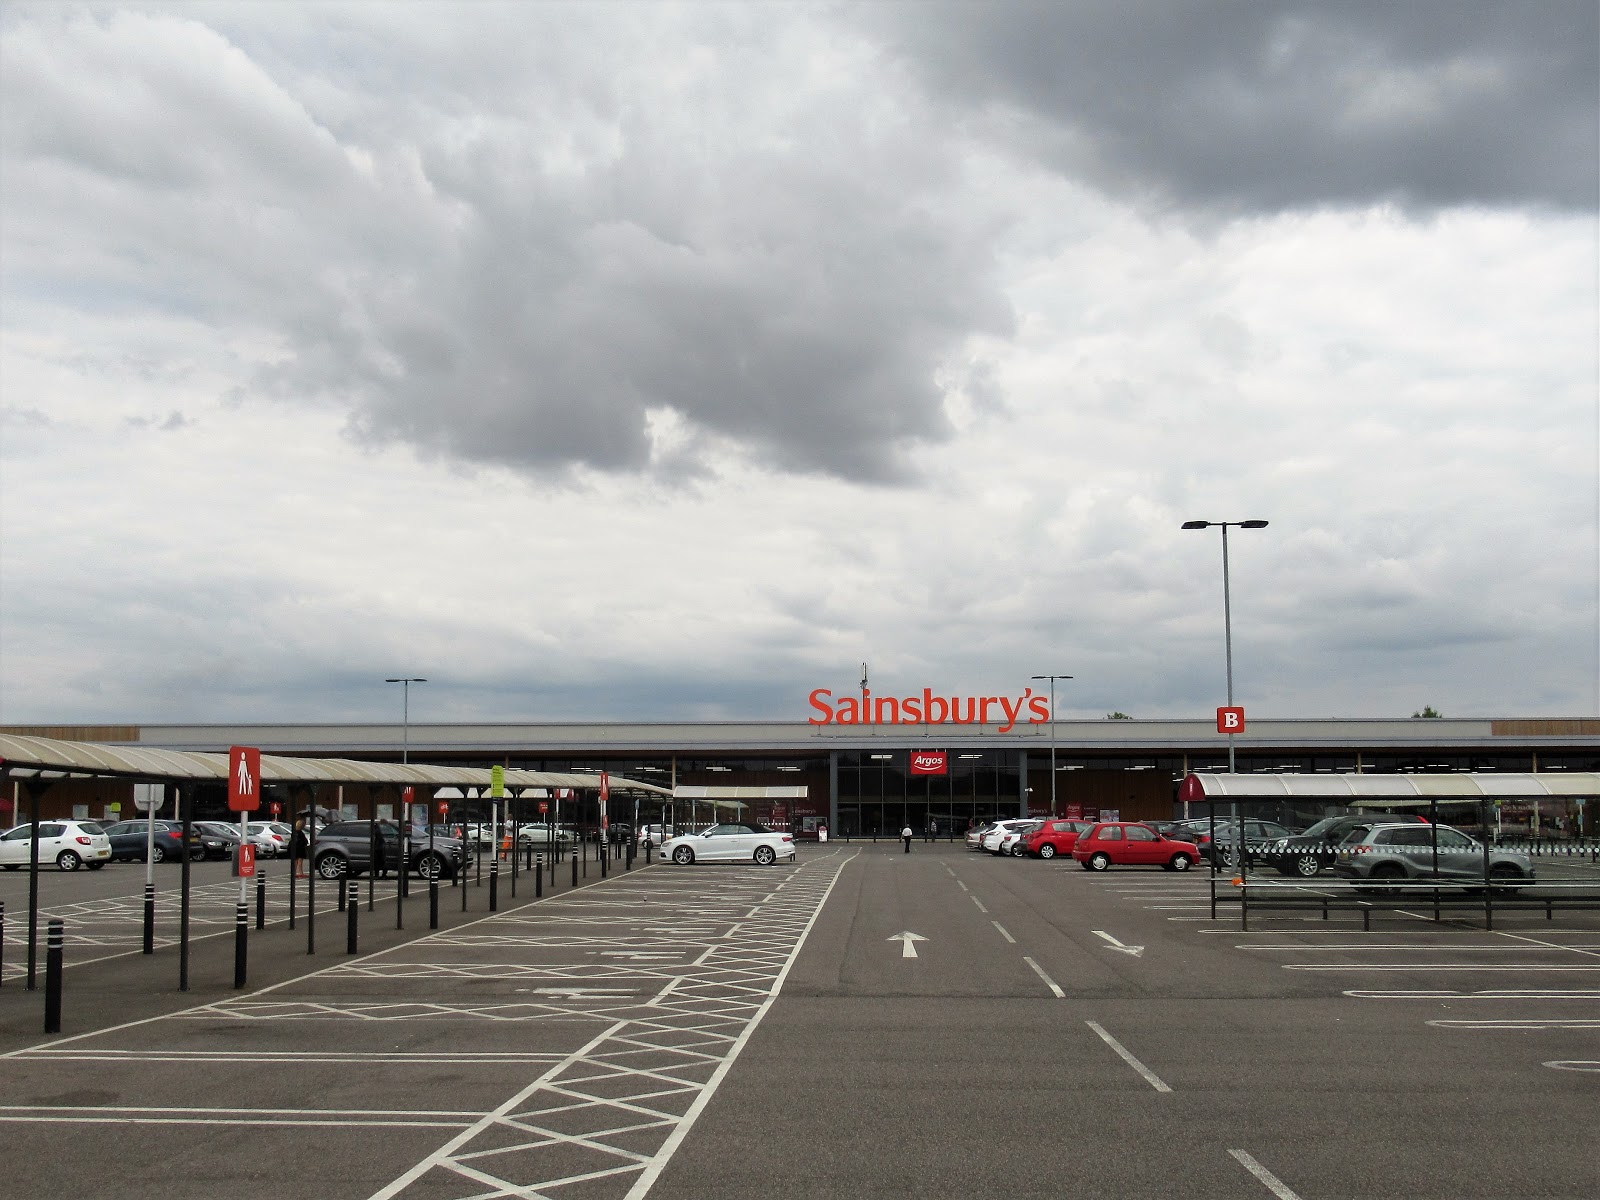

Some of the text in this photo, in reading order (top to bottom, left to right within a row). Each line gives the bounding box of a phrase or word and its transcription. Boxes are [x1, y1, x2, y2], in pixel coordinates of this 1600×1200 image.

[808, 688, 1050, 733] Sainsbury's
[1224, 712, 1239, 728] B
[914, 755, 943, 767] Argos
